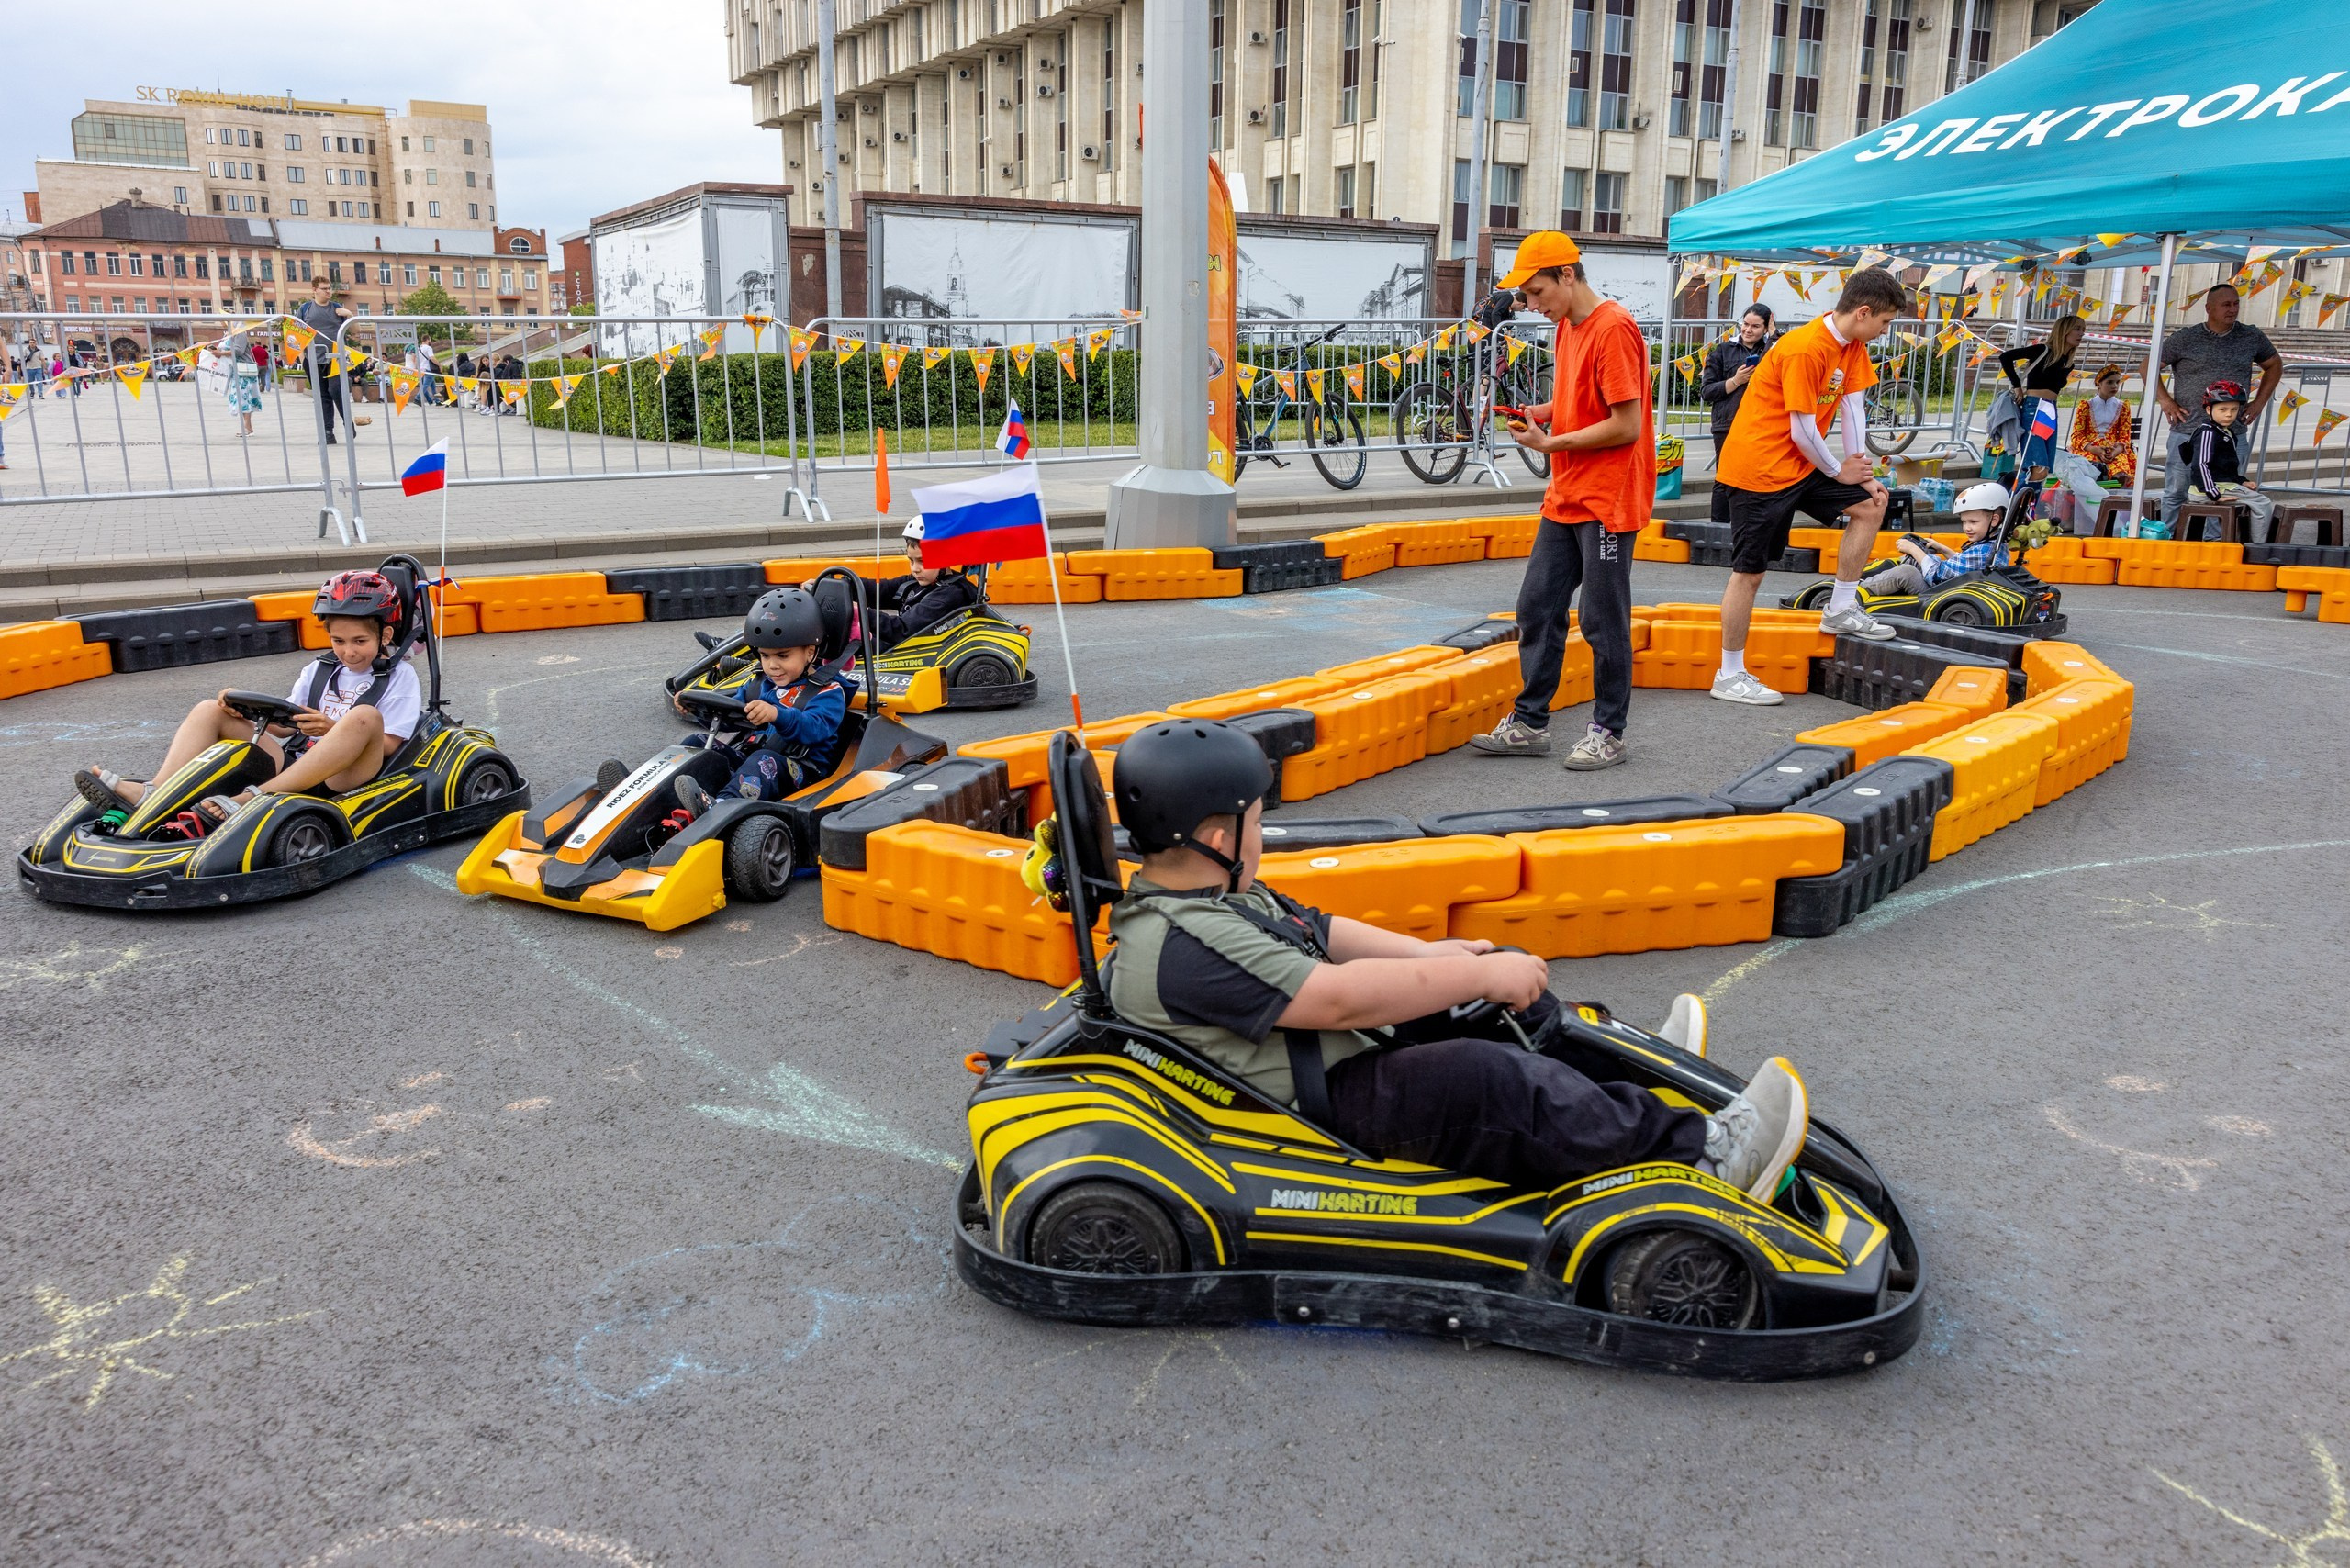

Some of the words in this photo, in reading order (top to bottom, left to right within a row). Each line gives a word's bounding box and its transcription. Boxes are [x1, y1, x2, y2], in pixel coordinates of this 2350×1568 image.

[136, 85, 161, 102] SK
[166, 87, 227, 105] ROYAL
[237, 94, 295, 111] HOTEL
[1606, 533, 1617, 563] ORT
[846, 673, 899, 685] FORULA
[607, 788, 632, 808] RIDEZ
[629, 760, 666, 789] FORMULA
